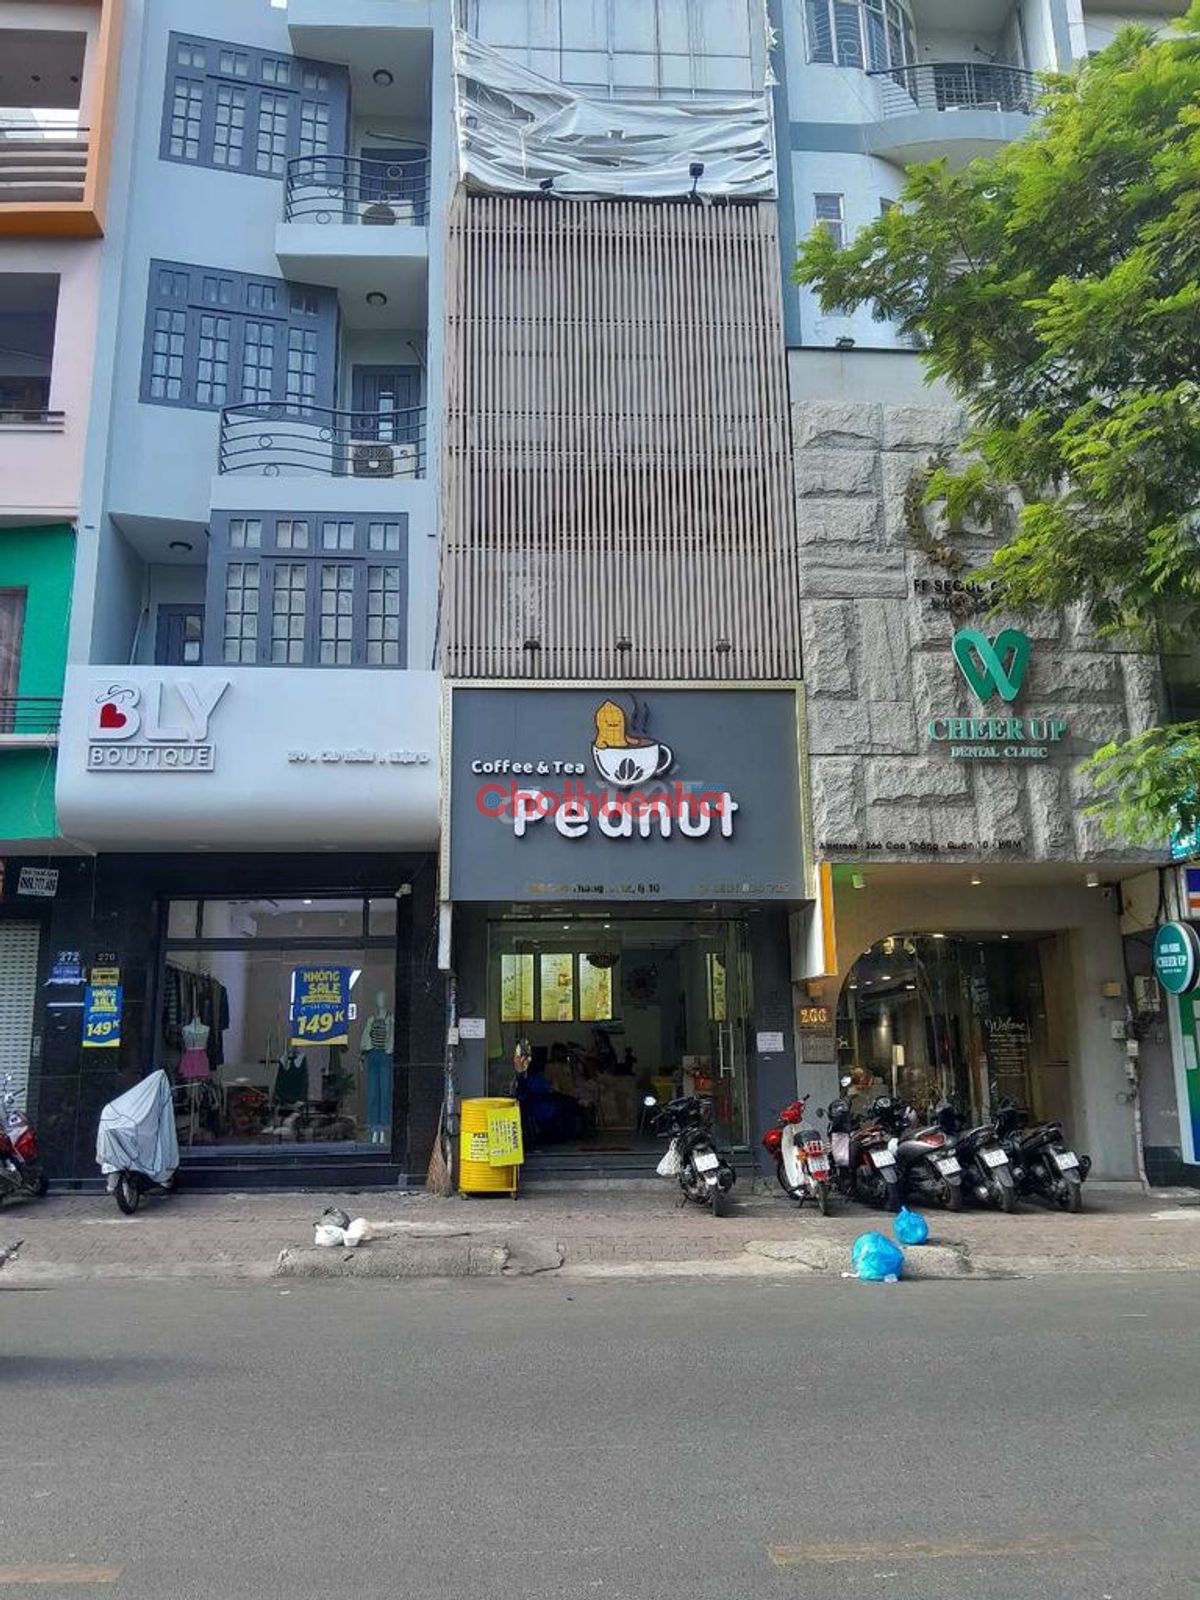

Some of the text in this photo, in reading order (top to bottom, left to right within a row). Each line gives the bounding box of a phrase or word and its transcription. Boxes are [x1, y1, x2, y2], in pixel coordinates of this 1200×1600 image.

[88, 680, 231, 742] BLY
[928, 717, 1067, 740] CHEER UP
[92, 748, 209, 766] BOUTIQUE
[951, 746, 1048, 757] DENTAL CLINIC
[471, 760, 586, 774] Coffee & Tea
[513, 788, 739, 838] Peanut
[308, 983, 340, 994] SALE
